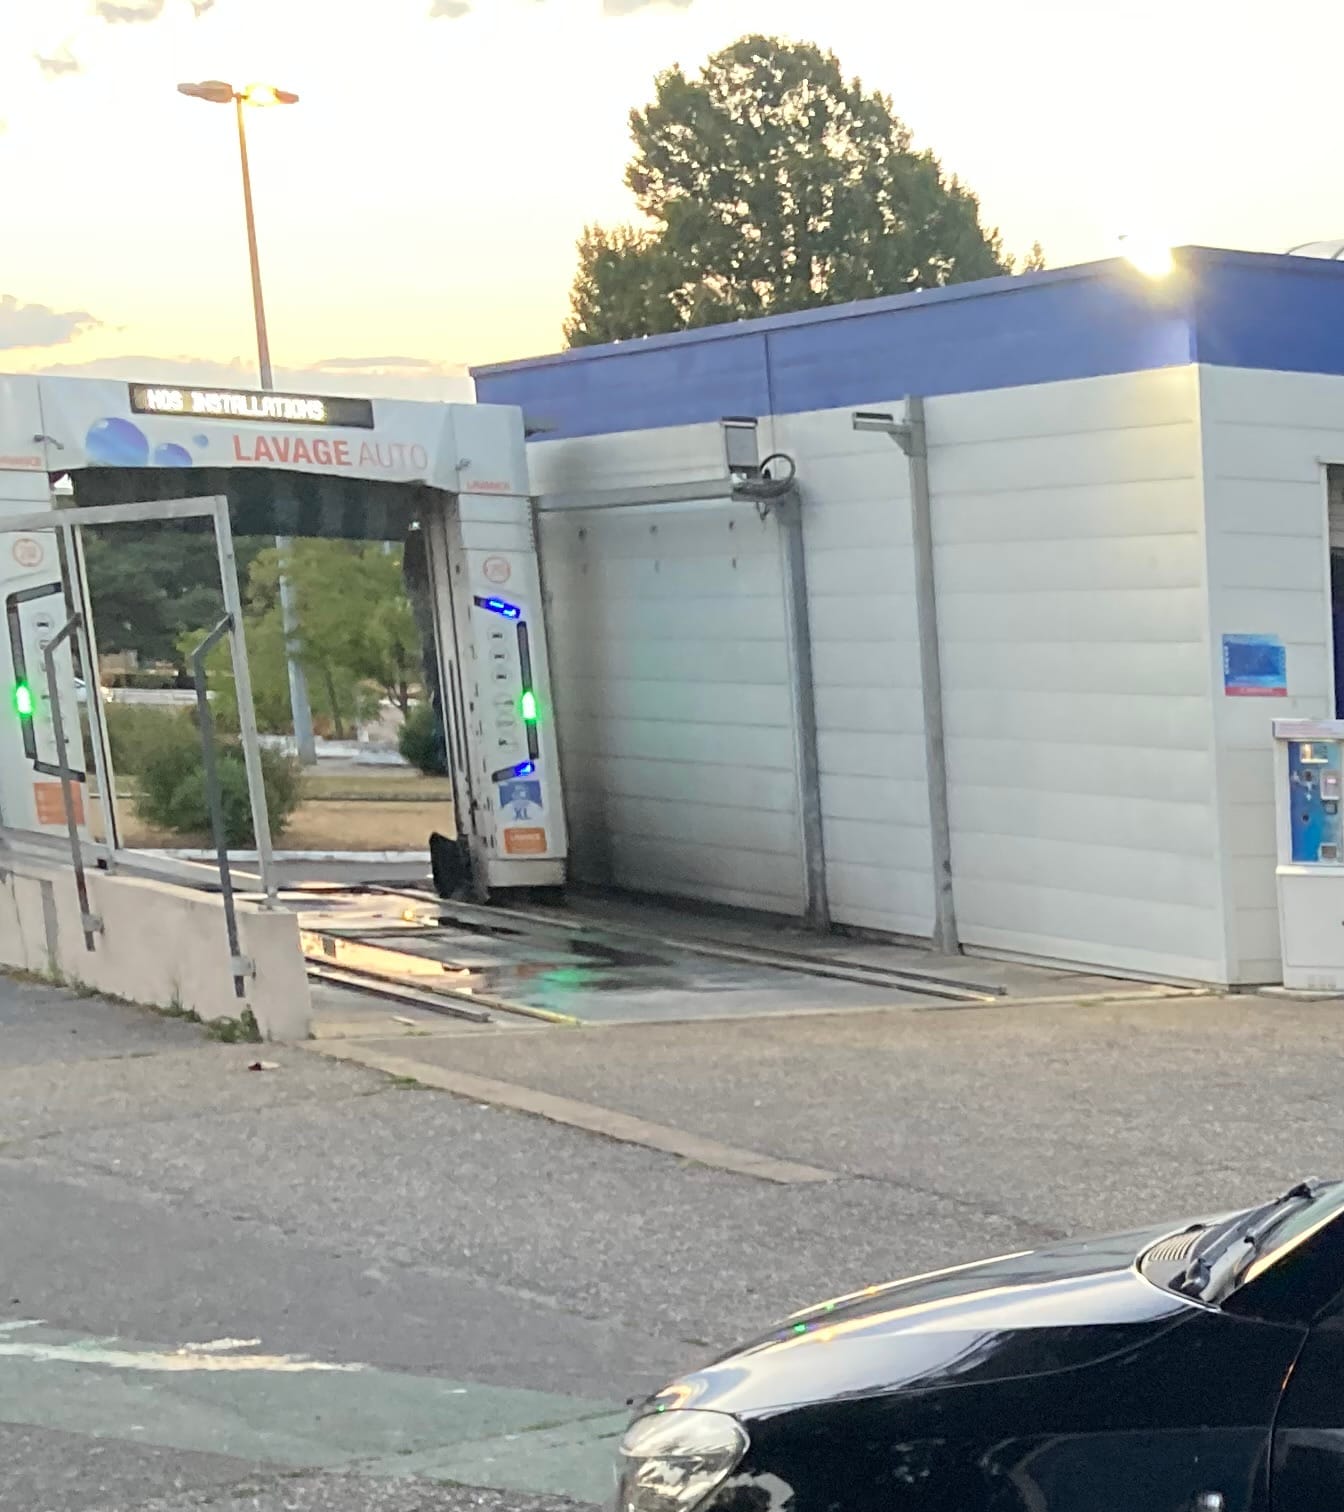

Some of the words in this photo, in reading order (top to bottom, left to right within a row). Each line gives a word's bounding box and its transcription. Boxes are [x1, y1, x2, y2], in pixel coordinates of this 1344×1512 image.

[191, 391, 326, 422] INSTALLATIONS
[233, 434, 352, 466] LAVAGE
[358, 440, 428, 471] AUTO
